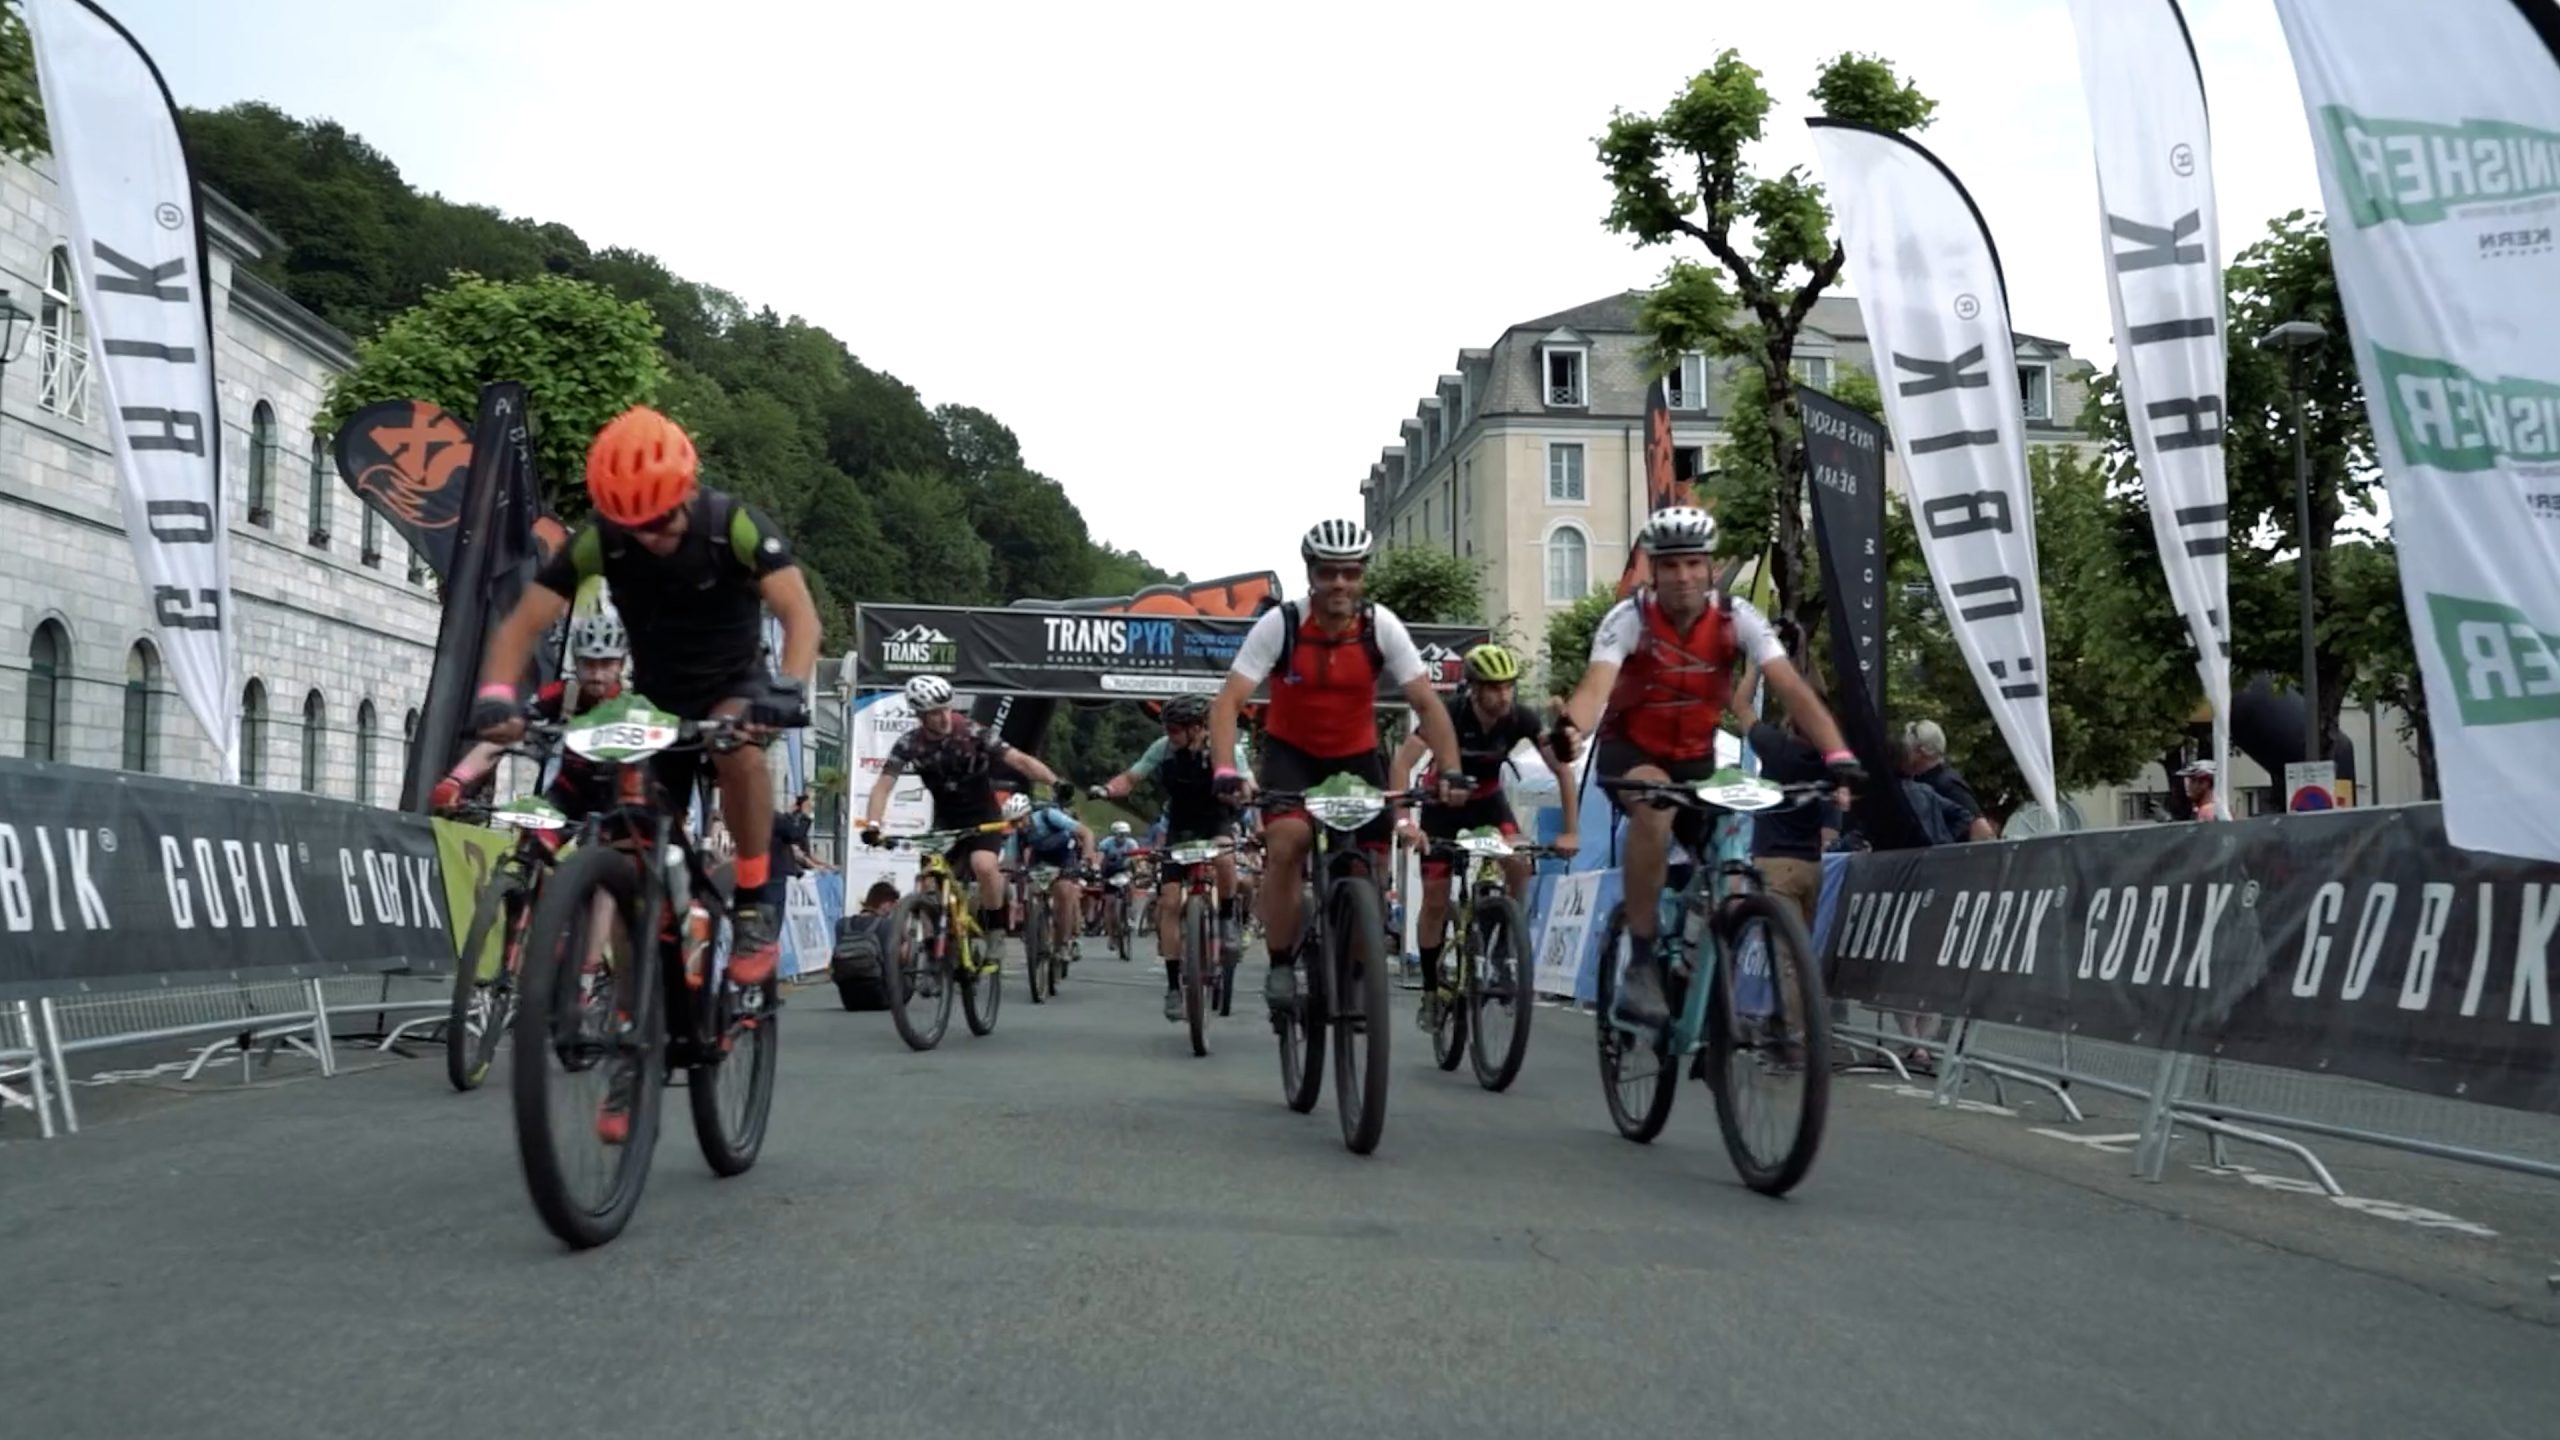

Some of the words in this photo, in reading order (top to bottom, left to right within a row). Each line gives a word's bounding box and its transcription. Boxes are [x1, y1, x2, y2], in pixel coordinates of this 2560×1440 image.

[881, 641, 957, 663] TRANSPYR
[1044, 617, 1176, 655] TRANSPYR
[2291, 881, 2560, 1026] GOBIK
